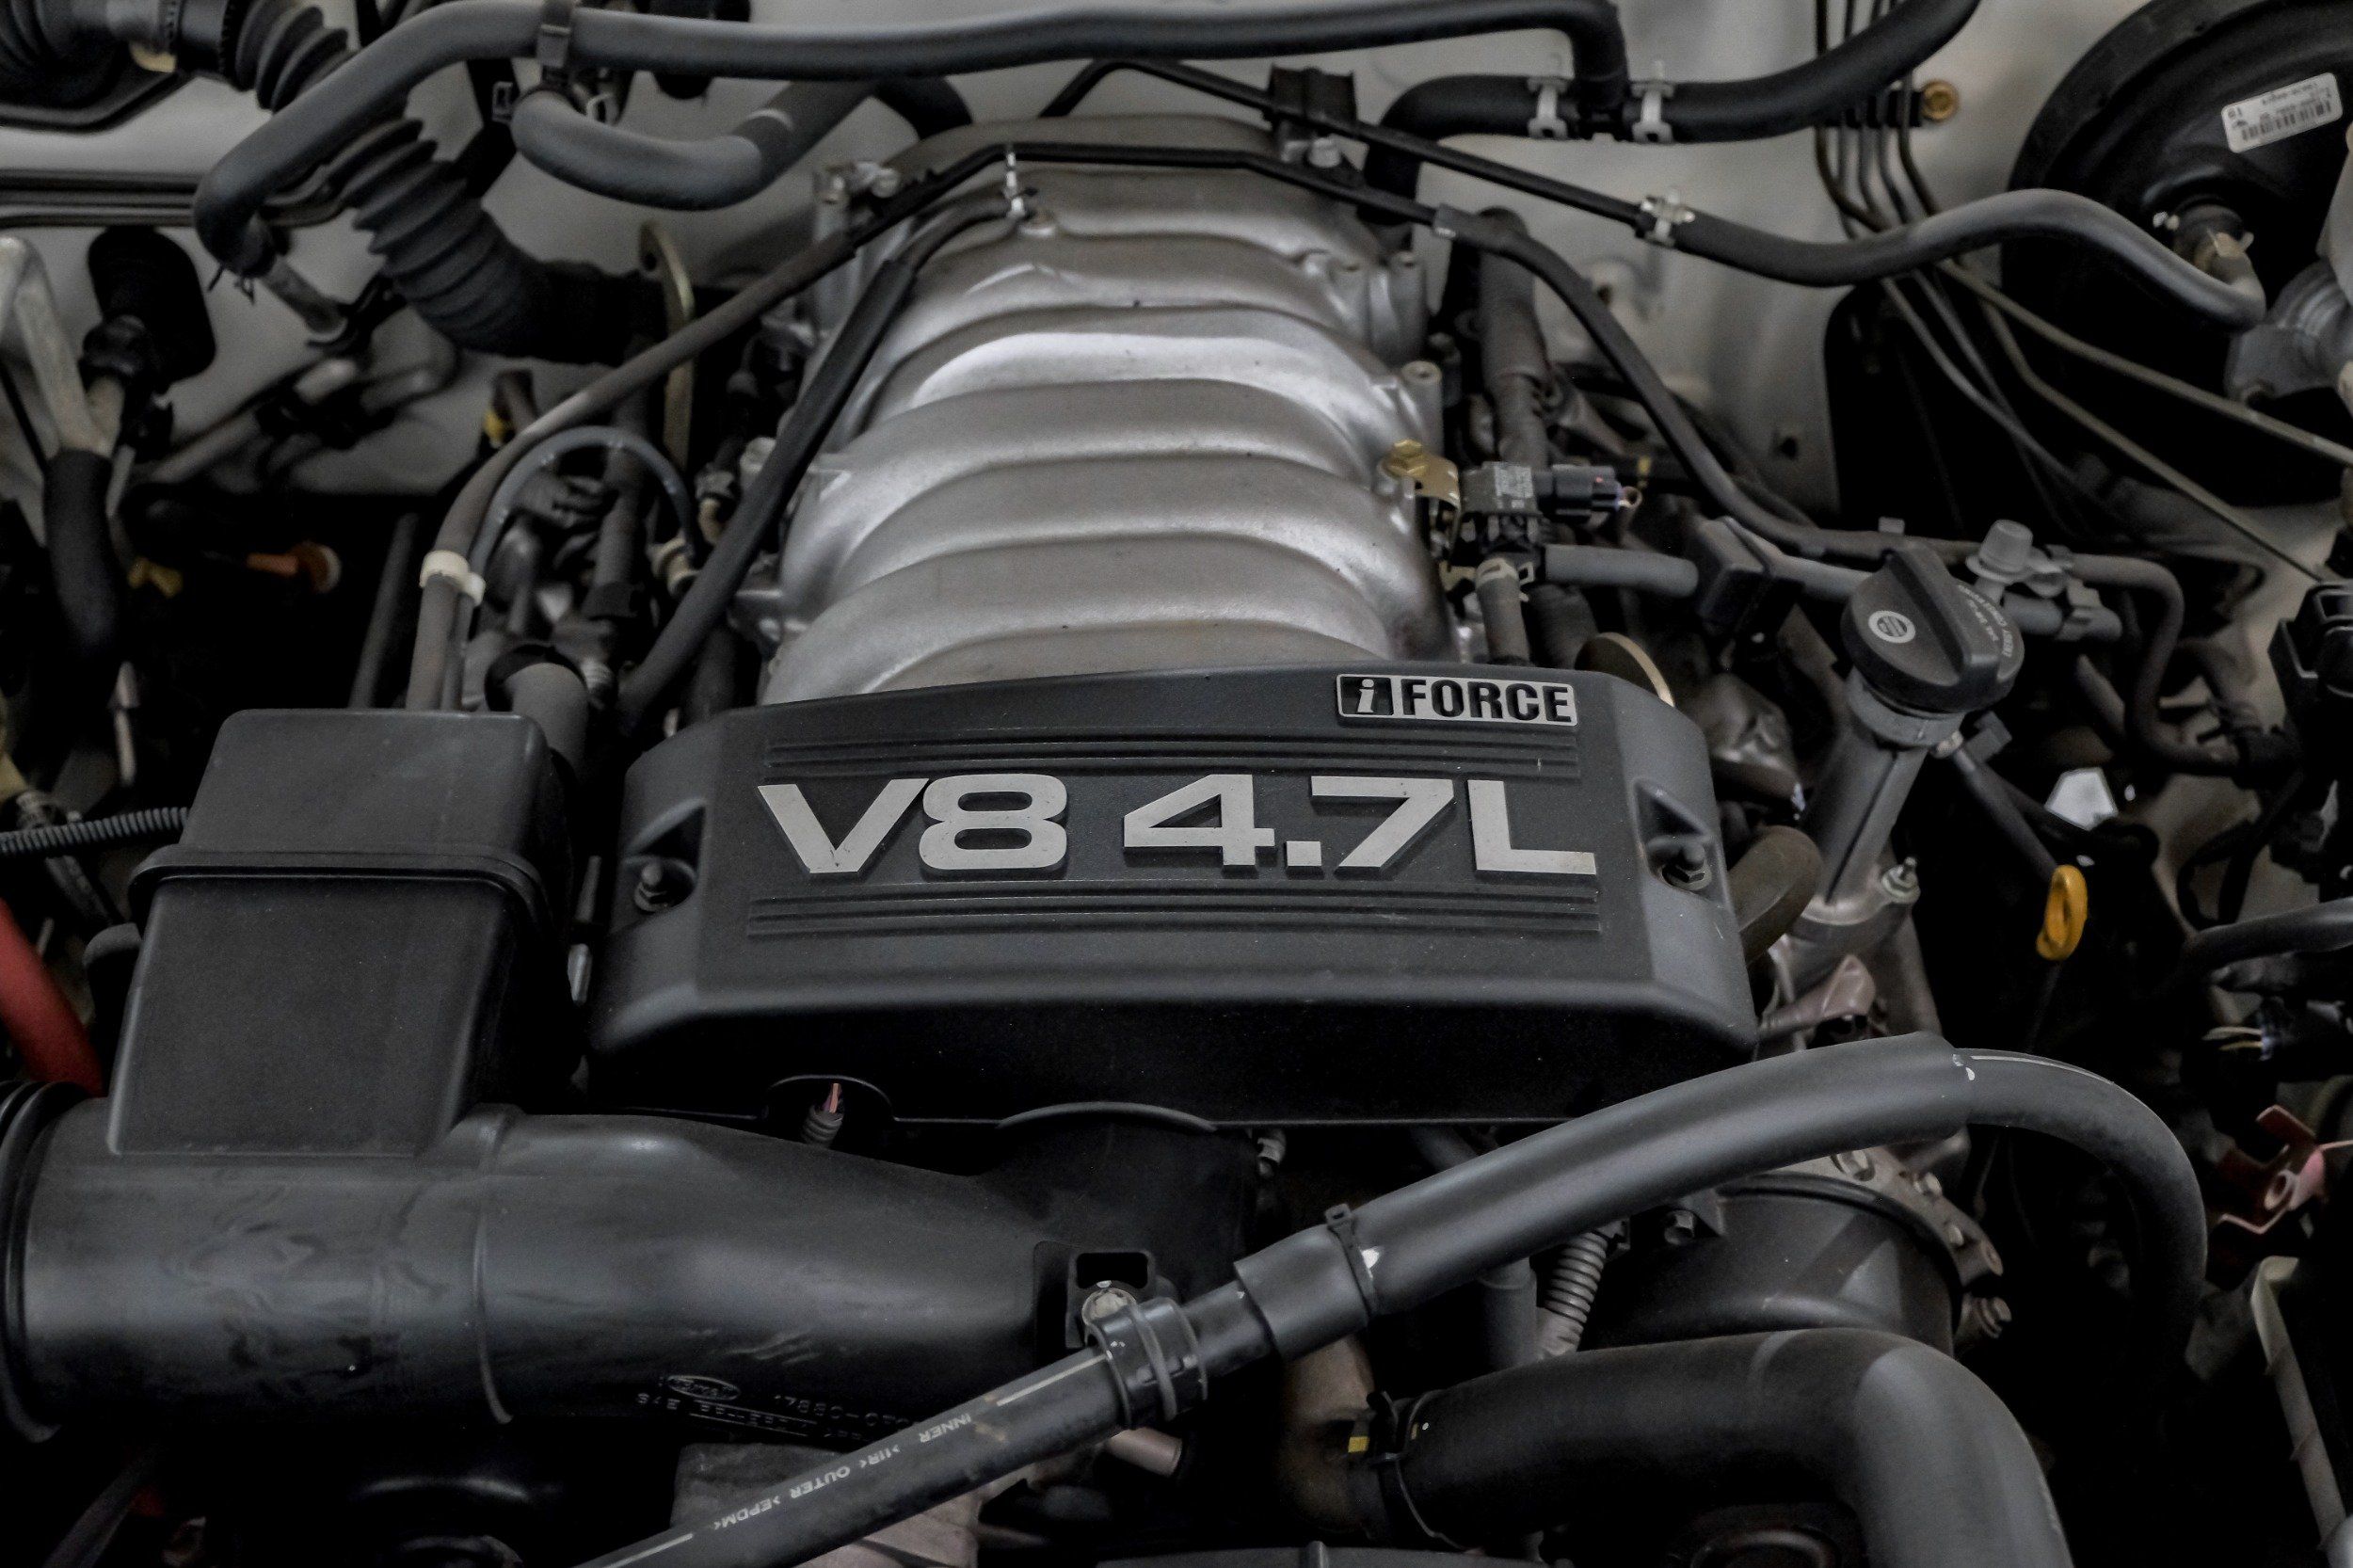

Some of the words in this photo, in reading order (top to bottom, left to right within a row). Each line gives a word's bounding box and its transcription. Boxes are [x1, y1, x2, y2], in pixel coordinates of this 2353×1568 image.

[1401, 678, 1572, 723] FORCE
[757, 773, 1069, 874] V8
[1123, 773, 1597, 876] 4.7L
[919, 1413, 972, 1443] INNER
[790, 1466, 851, 1498] OUTER
